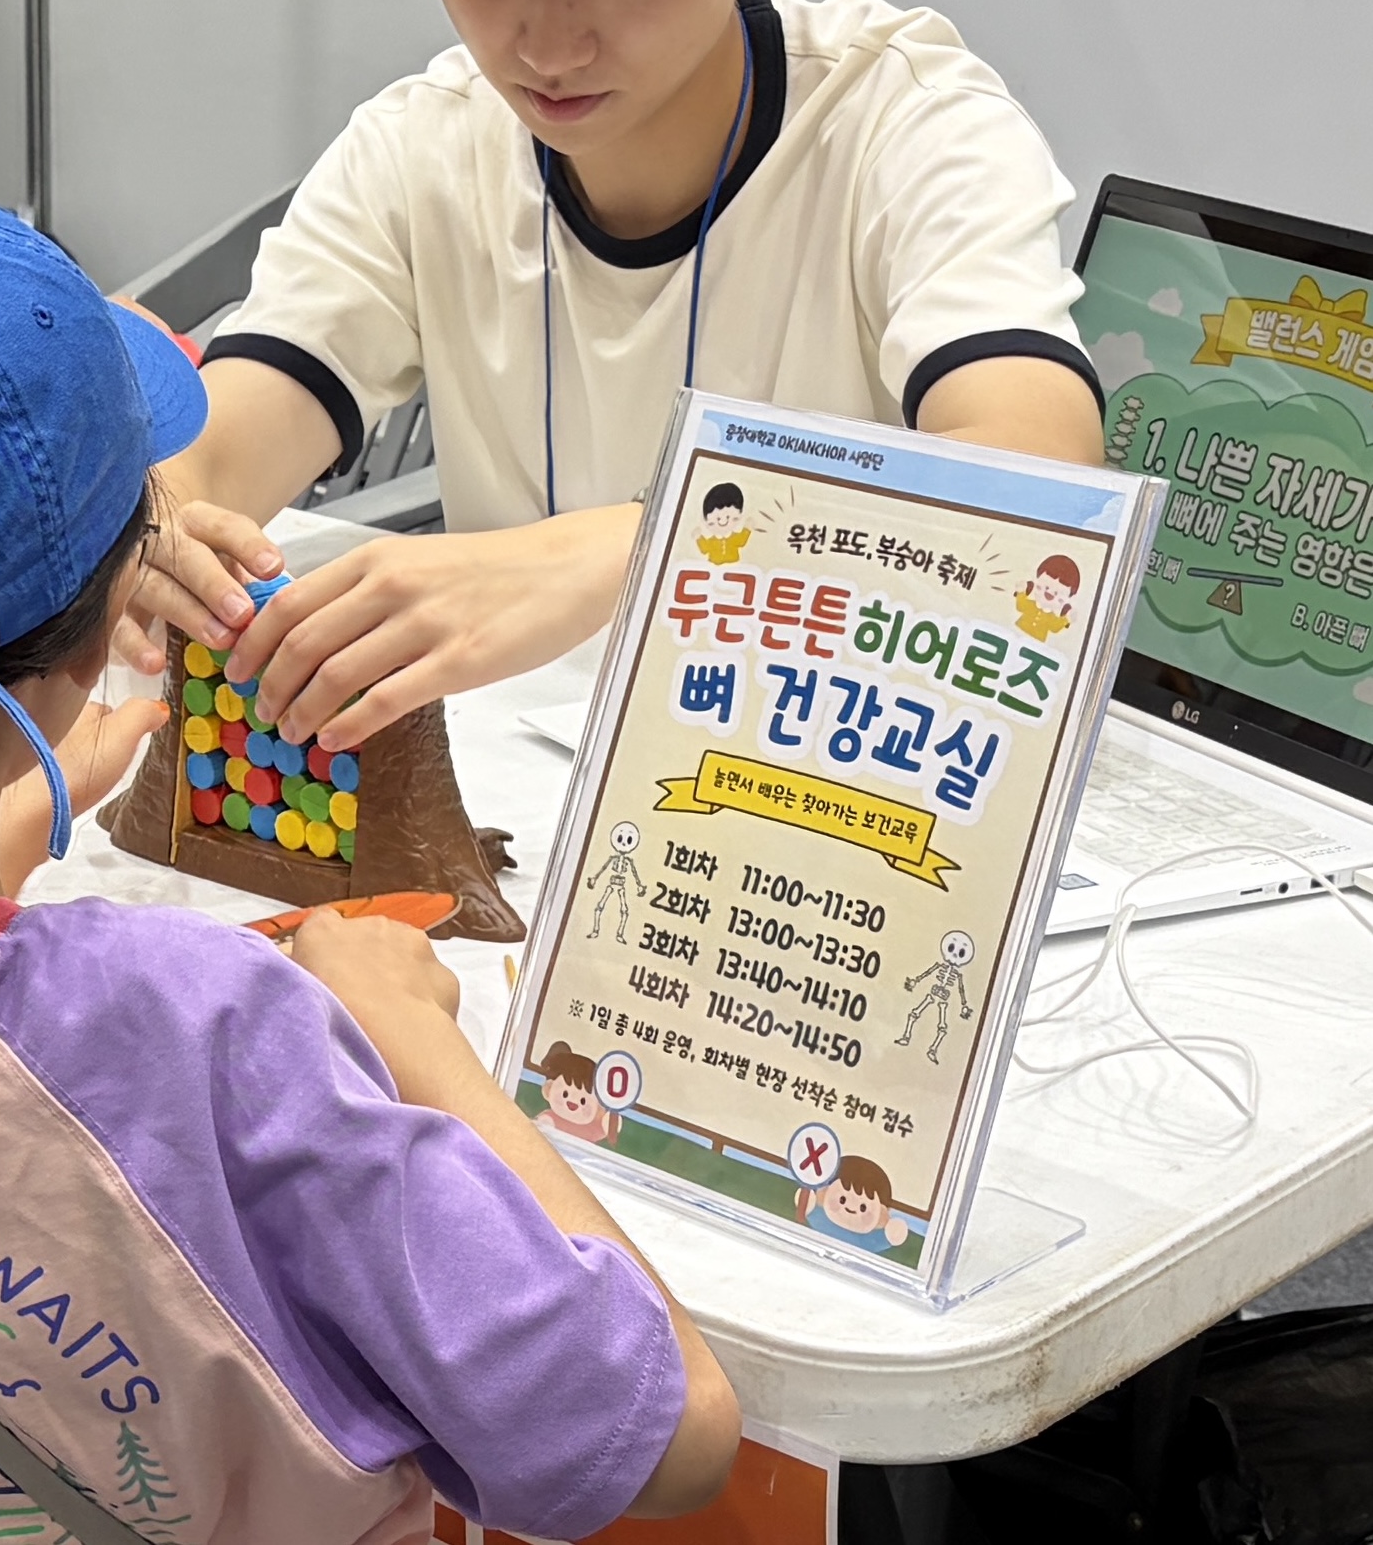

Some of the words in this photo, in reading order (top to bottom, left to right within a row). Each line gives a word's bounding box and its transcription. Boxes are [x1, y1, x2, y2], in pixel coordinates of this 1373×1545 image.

[1246, 309, 1324, 360] 밸런스
[1143, 417, 1167, 475] 1.
[1174, 427, 1259, 503] 나쁜
[787, 523, 827, 555] 옥천
[937, 553, 978, 591] 축제
[1165, 489, 1228, 547] 뼈에
[1228, 510, 1288, 568] 주는
[1291, 532, 1373, 600] 영향은
[1290, 602, 1309, 631] B.
[1312, 610, 1350, 645] 아픈
[1347, 622, 1371, 653] 뼈
[679, 662, 736, 724] 뼈
[766, 662, 1000, 812] 건강교실
[713, 766, 754, 794] 놀면서
[757, 781, 797, 810] 배우는
[801, 792, 858, 827] 찾아가는
[861, 810, 919, 845] 보건교육
[649, 881, 711, 925] 2회차
[727, 906, 881, 979] 13:00~13:30
[663, 840, 719, 881] 1회차
[741, 864, 886, 933] 11:00~11:30
[628, 964, 690, 1009] 4회차
[706, 990, 862, 1069] 14:20~14:50
[638, 922, 699, 967] 3회차
[716, 948, 868, 1022] 13:40~14:10
[589, 1003, 612, 1030] 1일
[615, 1012, 630, 1037] 총
[632, 1019, 660, 1045] 4회
[662, 1029, 696, 1063] 운영,
[701, 1046, 751, 1081] 회차별
[755, 1061, 788, 1094] 현장
[791, 1075, 838, 1112] 선착순
[842, 1093, 877, 1123] 참여
[881, 1106, 915, 1138] 접수
